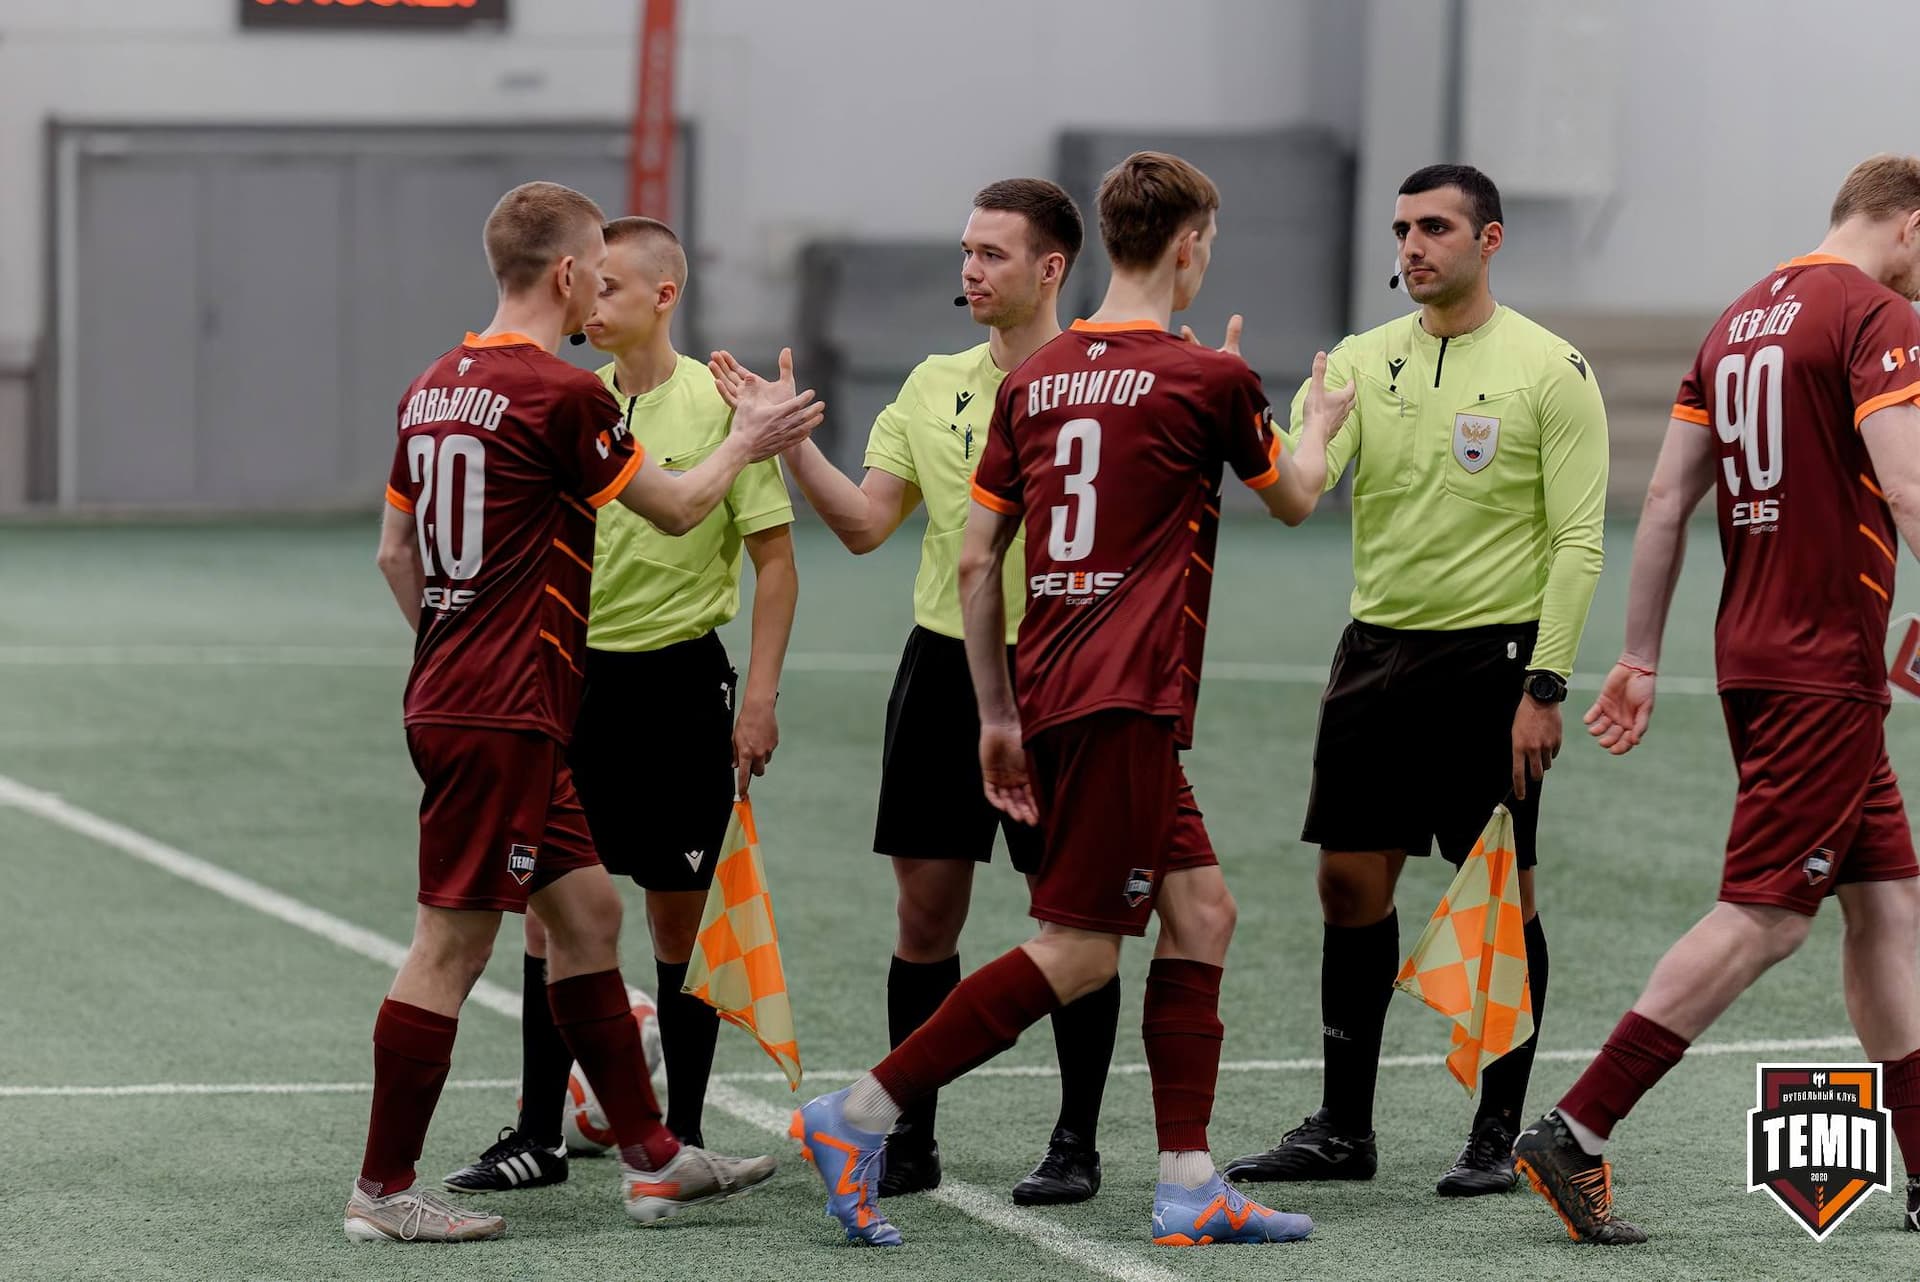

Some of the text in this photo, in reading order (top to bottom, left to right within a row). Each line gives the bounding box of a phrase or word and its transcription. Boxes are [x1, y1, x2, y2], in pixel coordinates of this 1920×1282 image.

[401, 387, 510, 431] ЗАВЬЯЛОВ
[1027, 369, 1155, 417] ВЕРНИГОР
[1715, 345, 1784, 496] 90
[407, 434, 486, 580] 20
[1048, 418, 1101, 562] 3
[1030, 571, 1125, 598] SEUS
